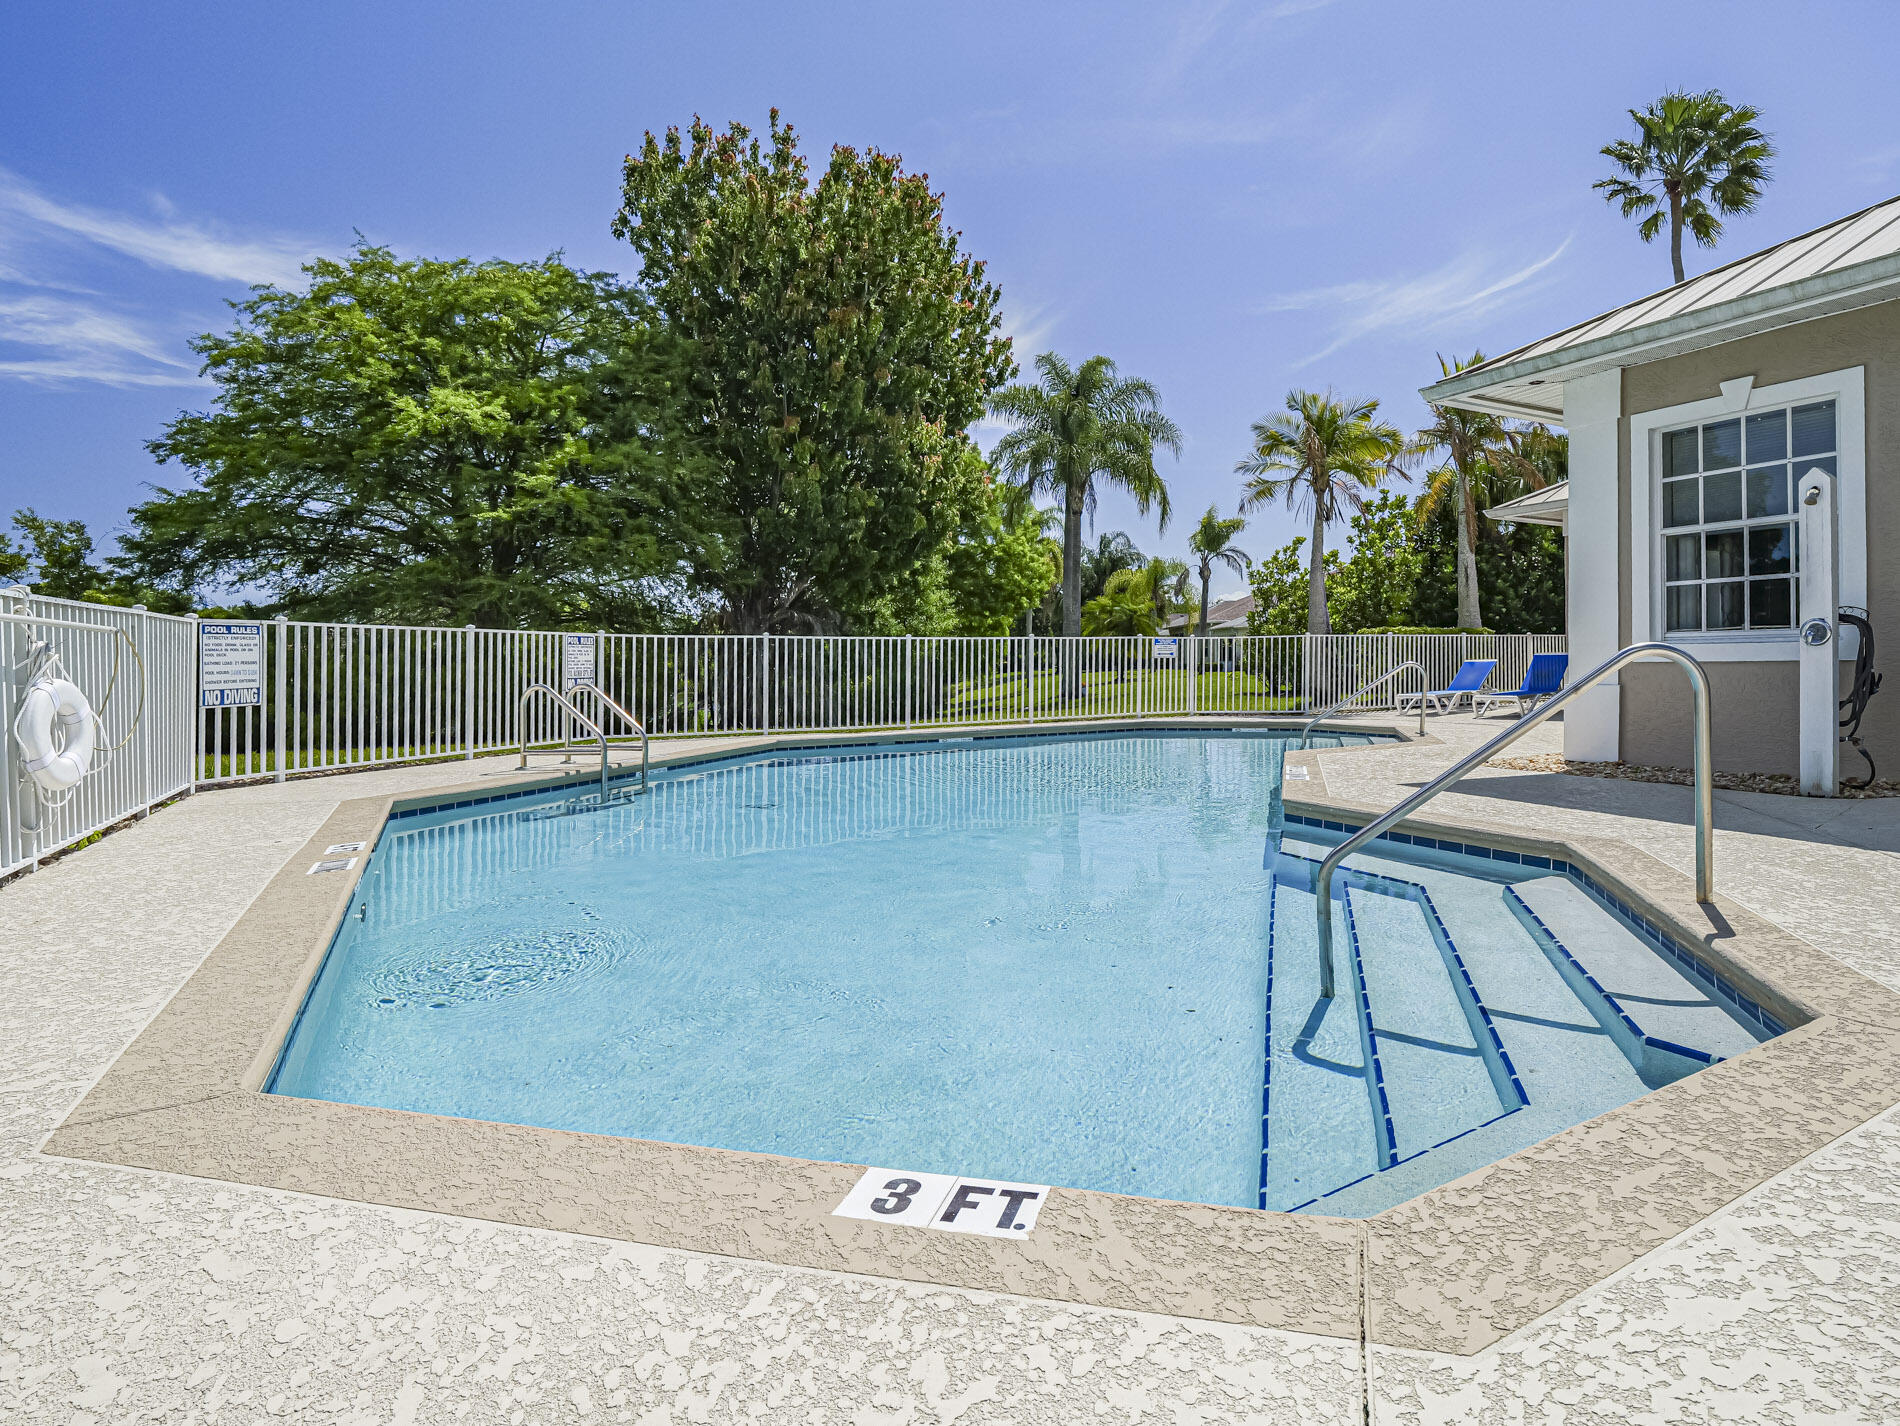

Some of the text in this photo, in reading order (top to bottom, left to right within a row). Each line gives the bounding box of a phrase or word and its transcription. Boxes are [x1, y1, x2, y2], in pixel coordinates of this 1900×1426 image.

[204, 626, 258, 634] POOL RULES
[204, 688, 258, 706] NO DIVING
[869, 1177, 1040, 1231] 3 FT.
